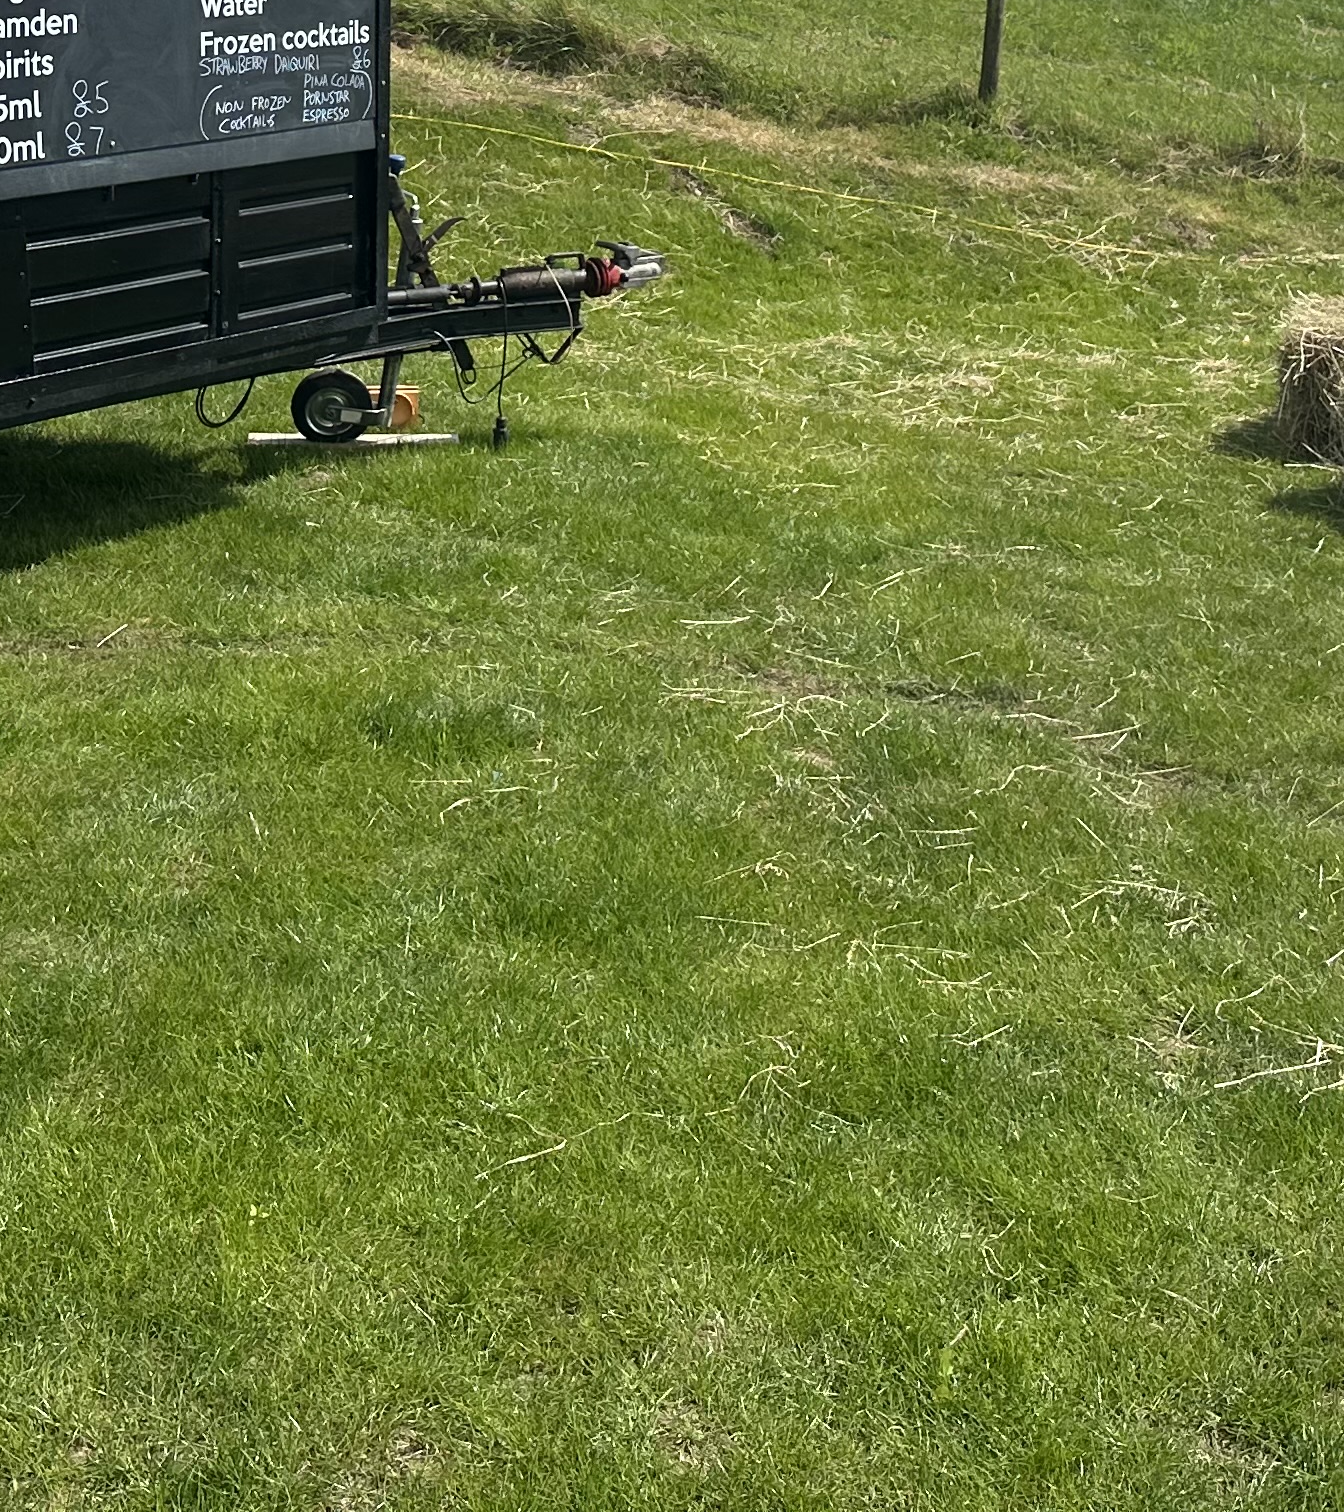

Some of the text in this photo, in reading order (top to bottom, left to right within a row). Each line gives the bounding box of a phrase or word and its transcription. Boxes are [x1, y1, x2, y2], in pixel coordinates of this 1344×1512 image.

[200, 19, 370, 57] Frozen cocktails
[72, 80, 109, 118] £5
[215, 95, 292, 116] NON FROZEN
[303, 89, 351, 108] PORNSTAR
[218, 114, 276, 134] COCKTAILS
[302, 107, 350, 124] ESPRESSO
